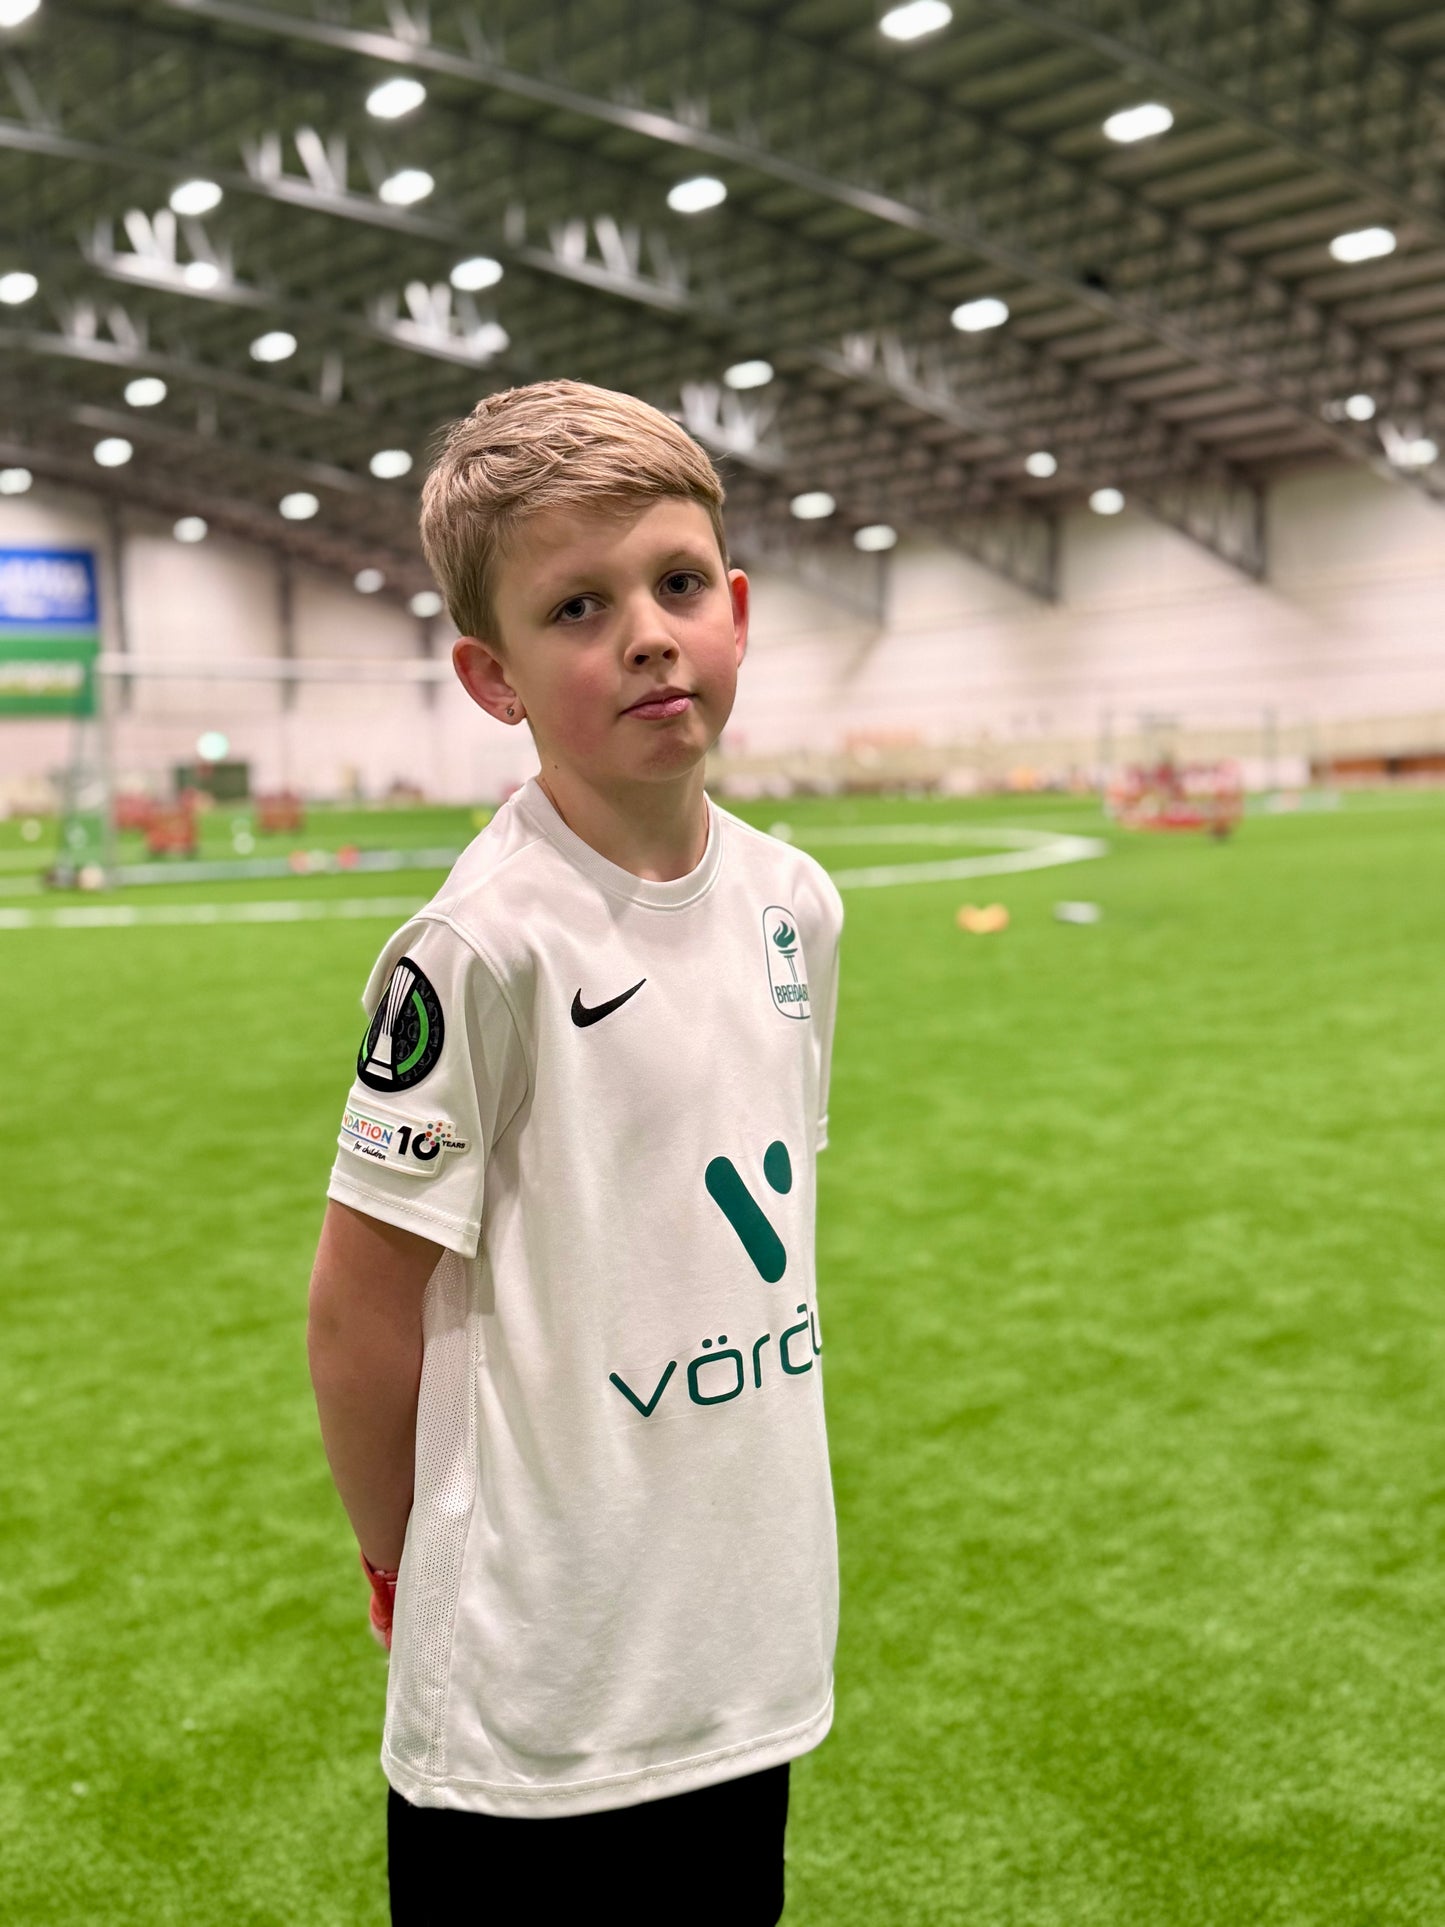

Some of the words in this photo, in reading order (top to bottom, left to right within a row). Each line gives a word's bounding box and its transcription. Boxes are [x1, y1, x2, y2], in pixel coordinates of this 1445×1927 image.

[352, 1141, 362, 1152] for
[362, 1146, 387, 1161] children
[397, 1125, 440, 1161] 10
[441, 1140, 466, 1149] YEARS
